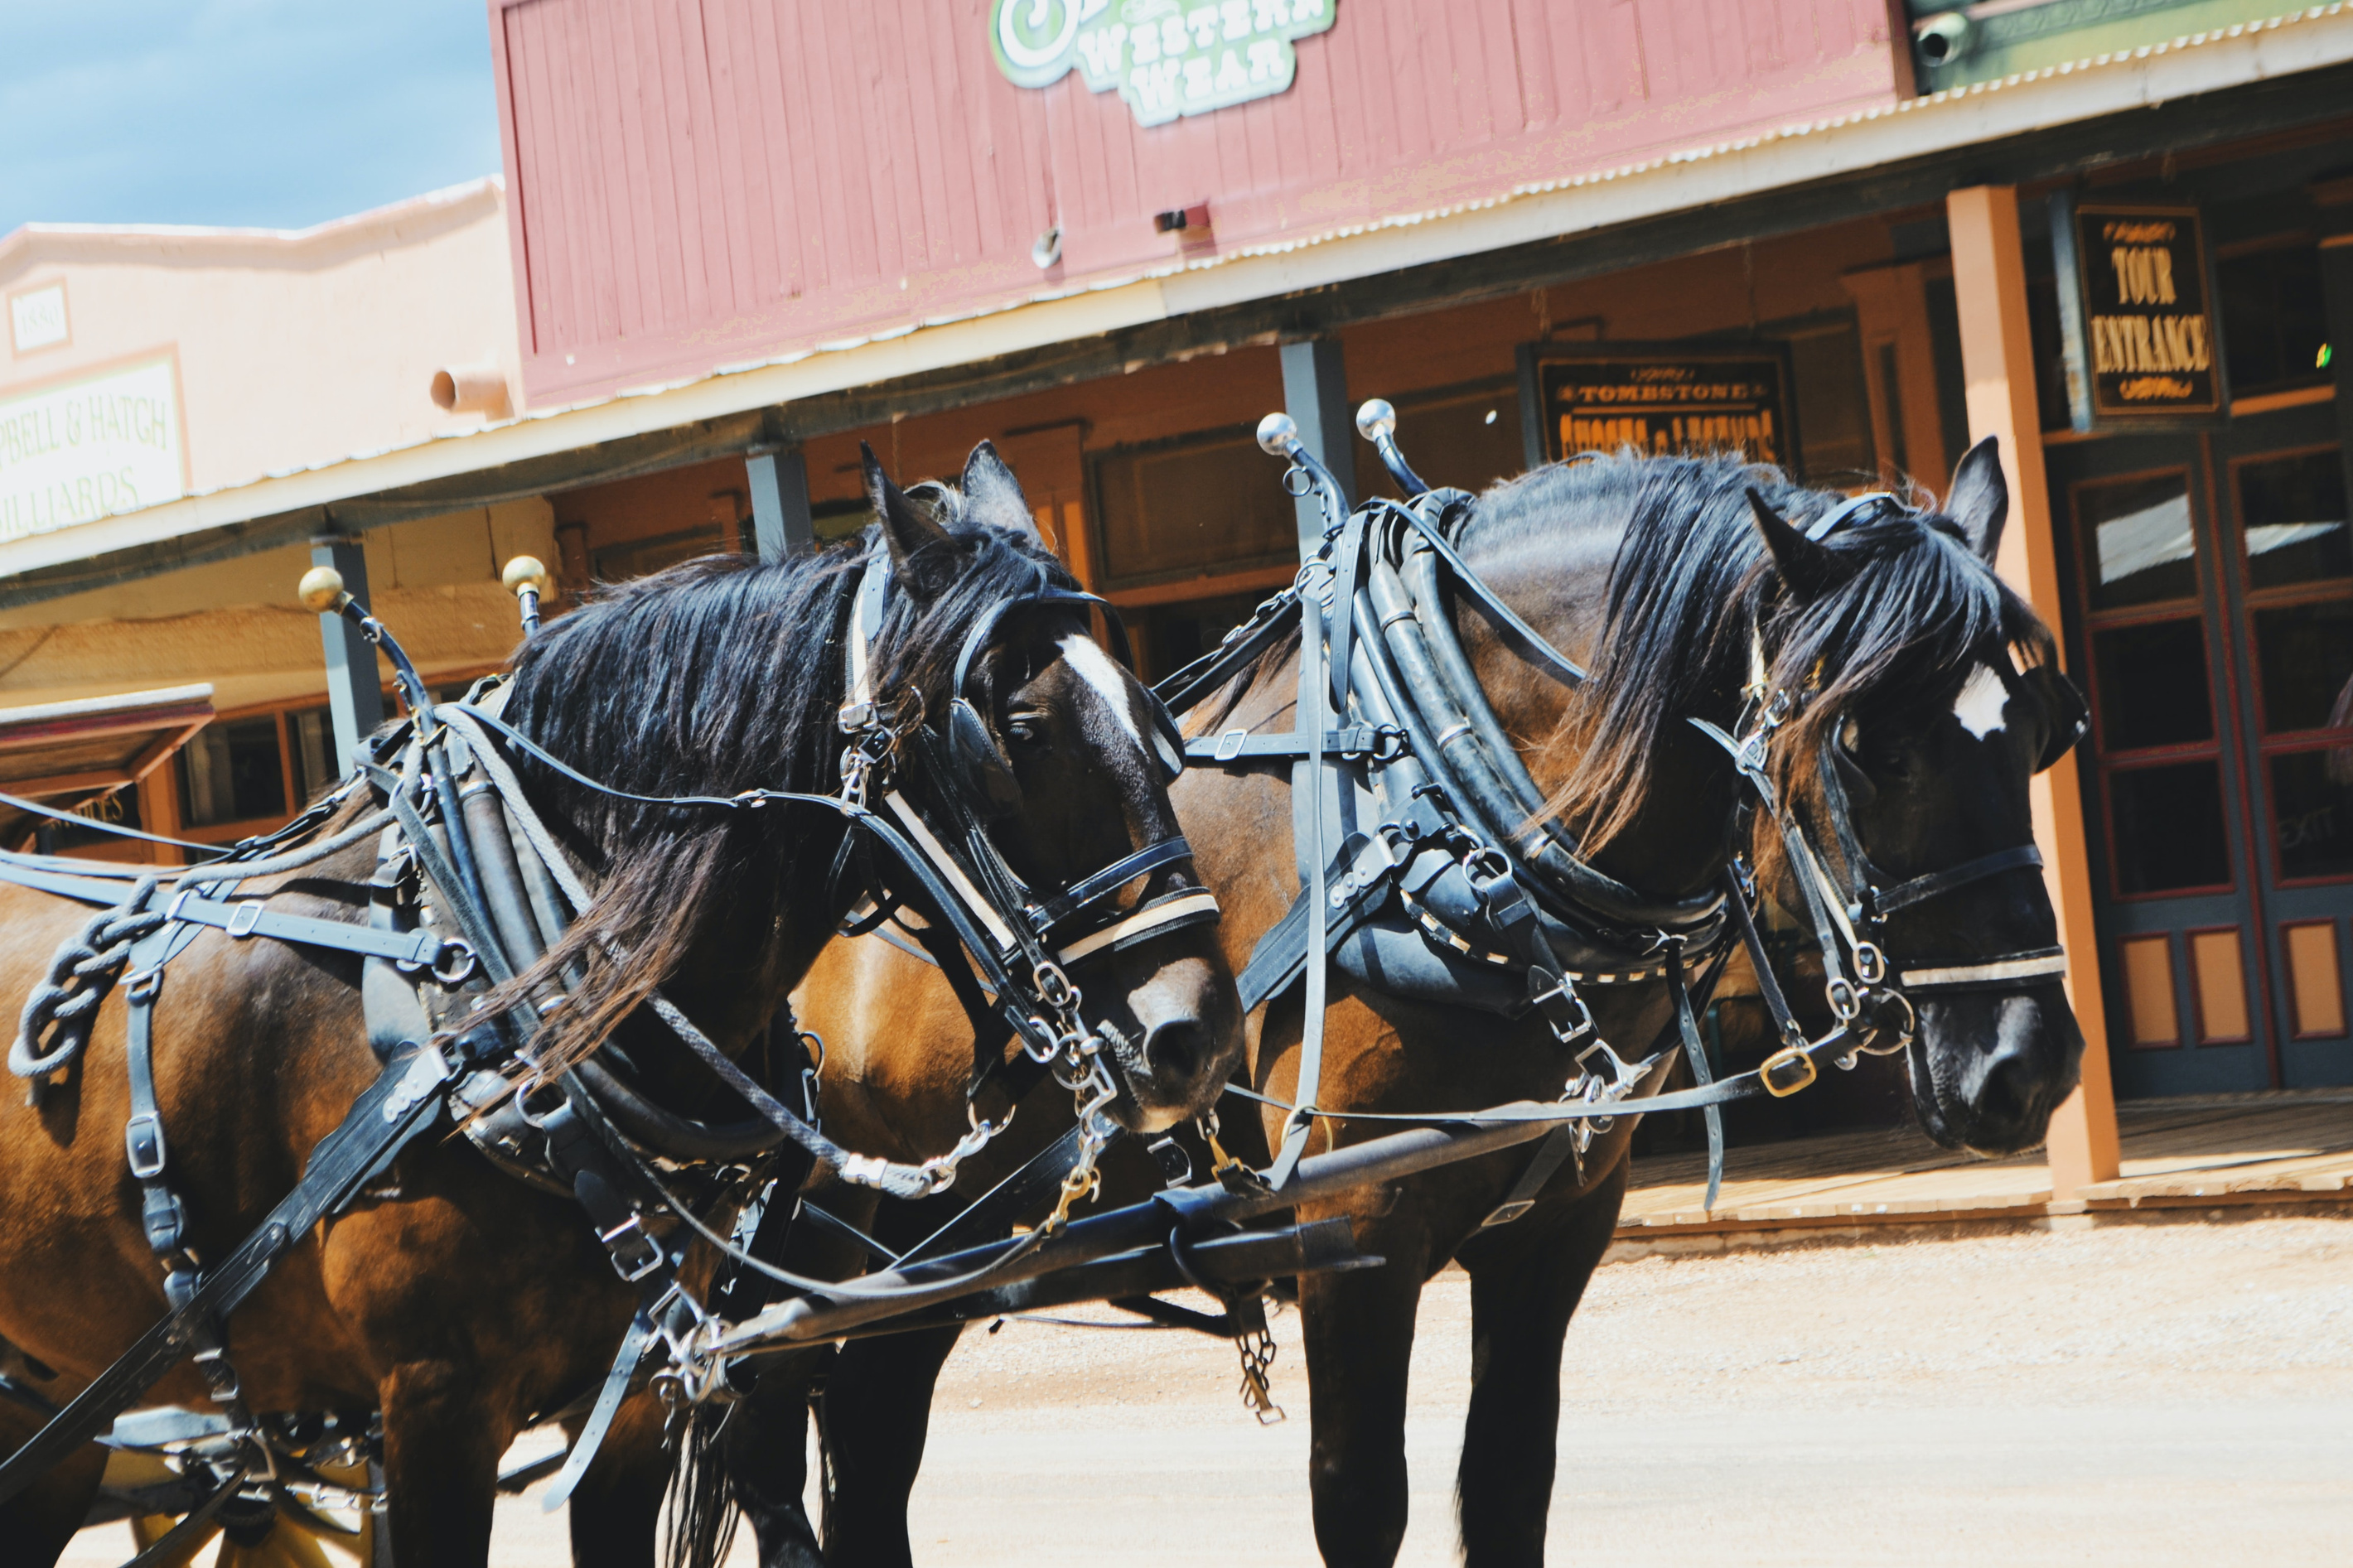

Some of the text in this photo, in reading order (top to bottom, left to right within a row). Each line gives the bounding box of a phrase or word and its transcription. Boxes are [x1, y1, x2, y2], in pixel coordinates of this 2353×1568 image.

[1077, 0, 1324, 76] WESTERN
[1129, 38, 1286, 113] WEAR
[2111, 247, 2177, 305] TOUR
[2091, 314, 2210, 373] ENTRANCE
[1578, 383, 1749, 403] TOMBSTONE
[66, 398, 81, 448] &
[0, 466, 138, 533] ILLIARDS
[2277, 806, 2333, 848] EXIT
